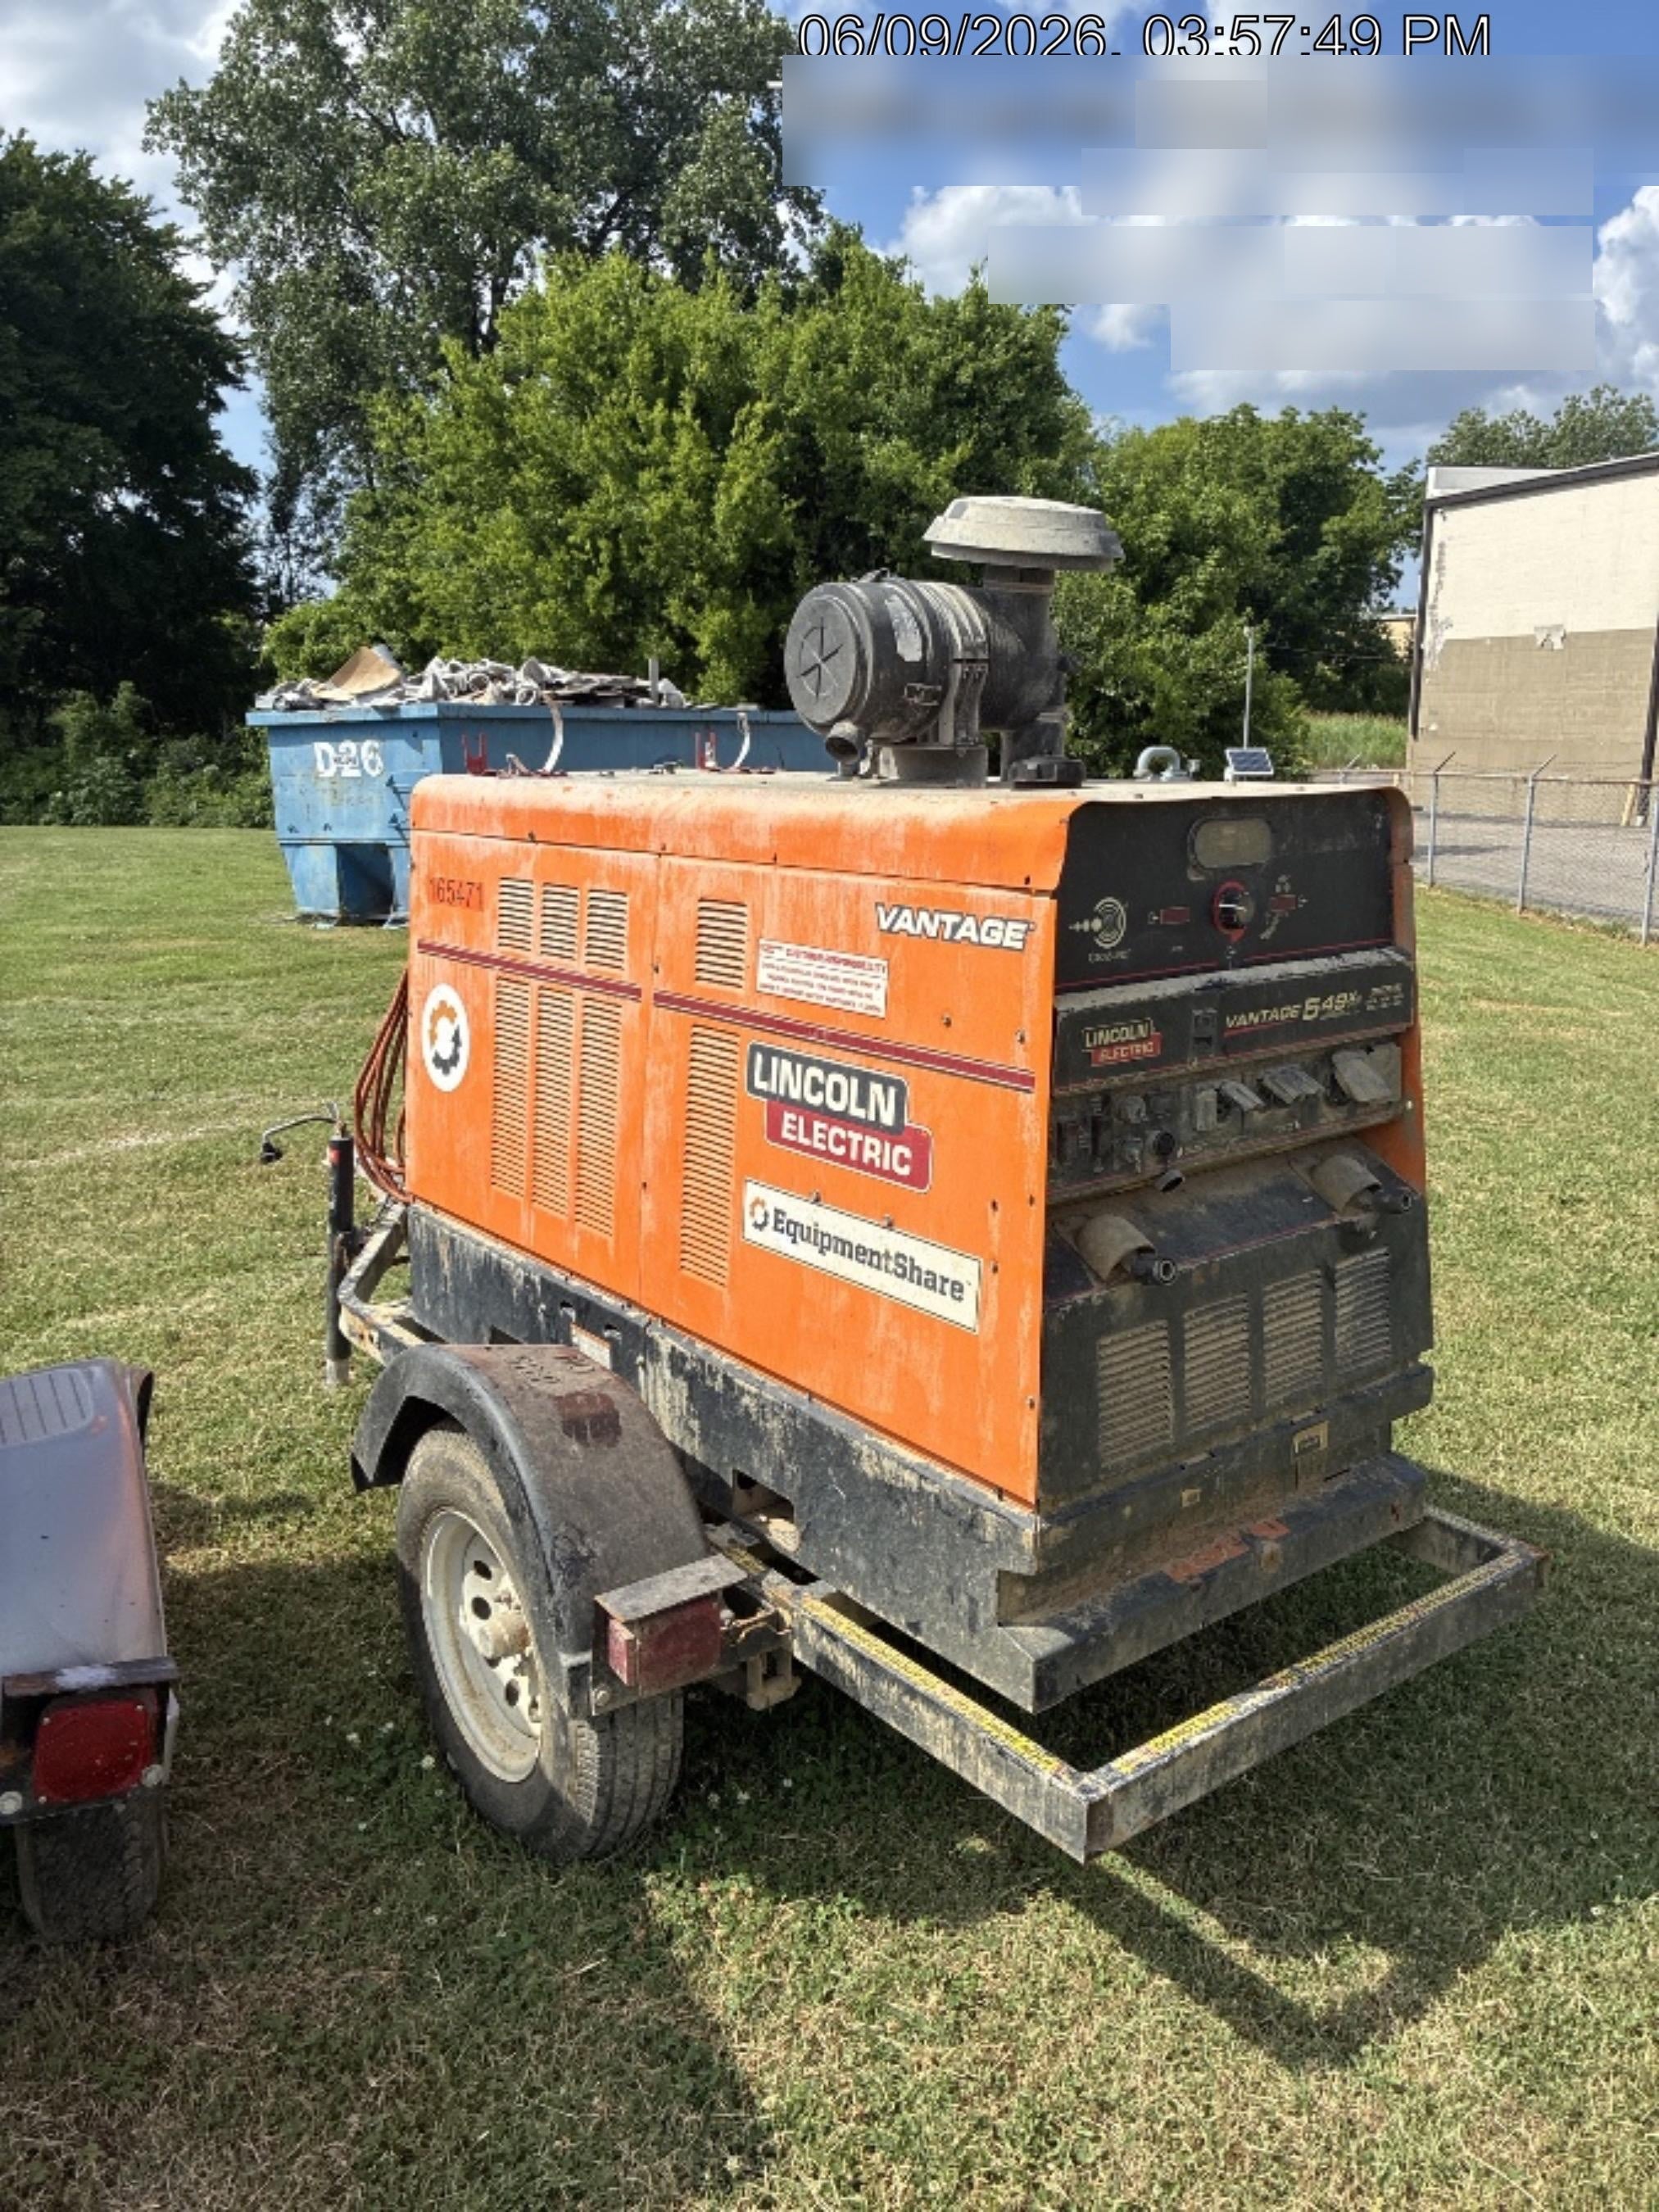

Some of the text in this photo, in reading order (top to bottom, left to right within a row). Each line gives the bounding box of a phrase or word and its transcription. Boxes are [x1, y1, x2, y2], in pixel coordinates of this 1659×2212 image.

[876, 903, 1030, 950] VANTAGE
[1086, 1020, 1149, 1048] LINCOLN
[1226, 1004, 1301, 1028] VANTAGE
[754, 1052, 896, 1126] LINCOLN
[781, 1110, 913, 1176] ELECTRIC
[773, 1206, 965, 1303] EquipmentShare
